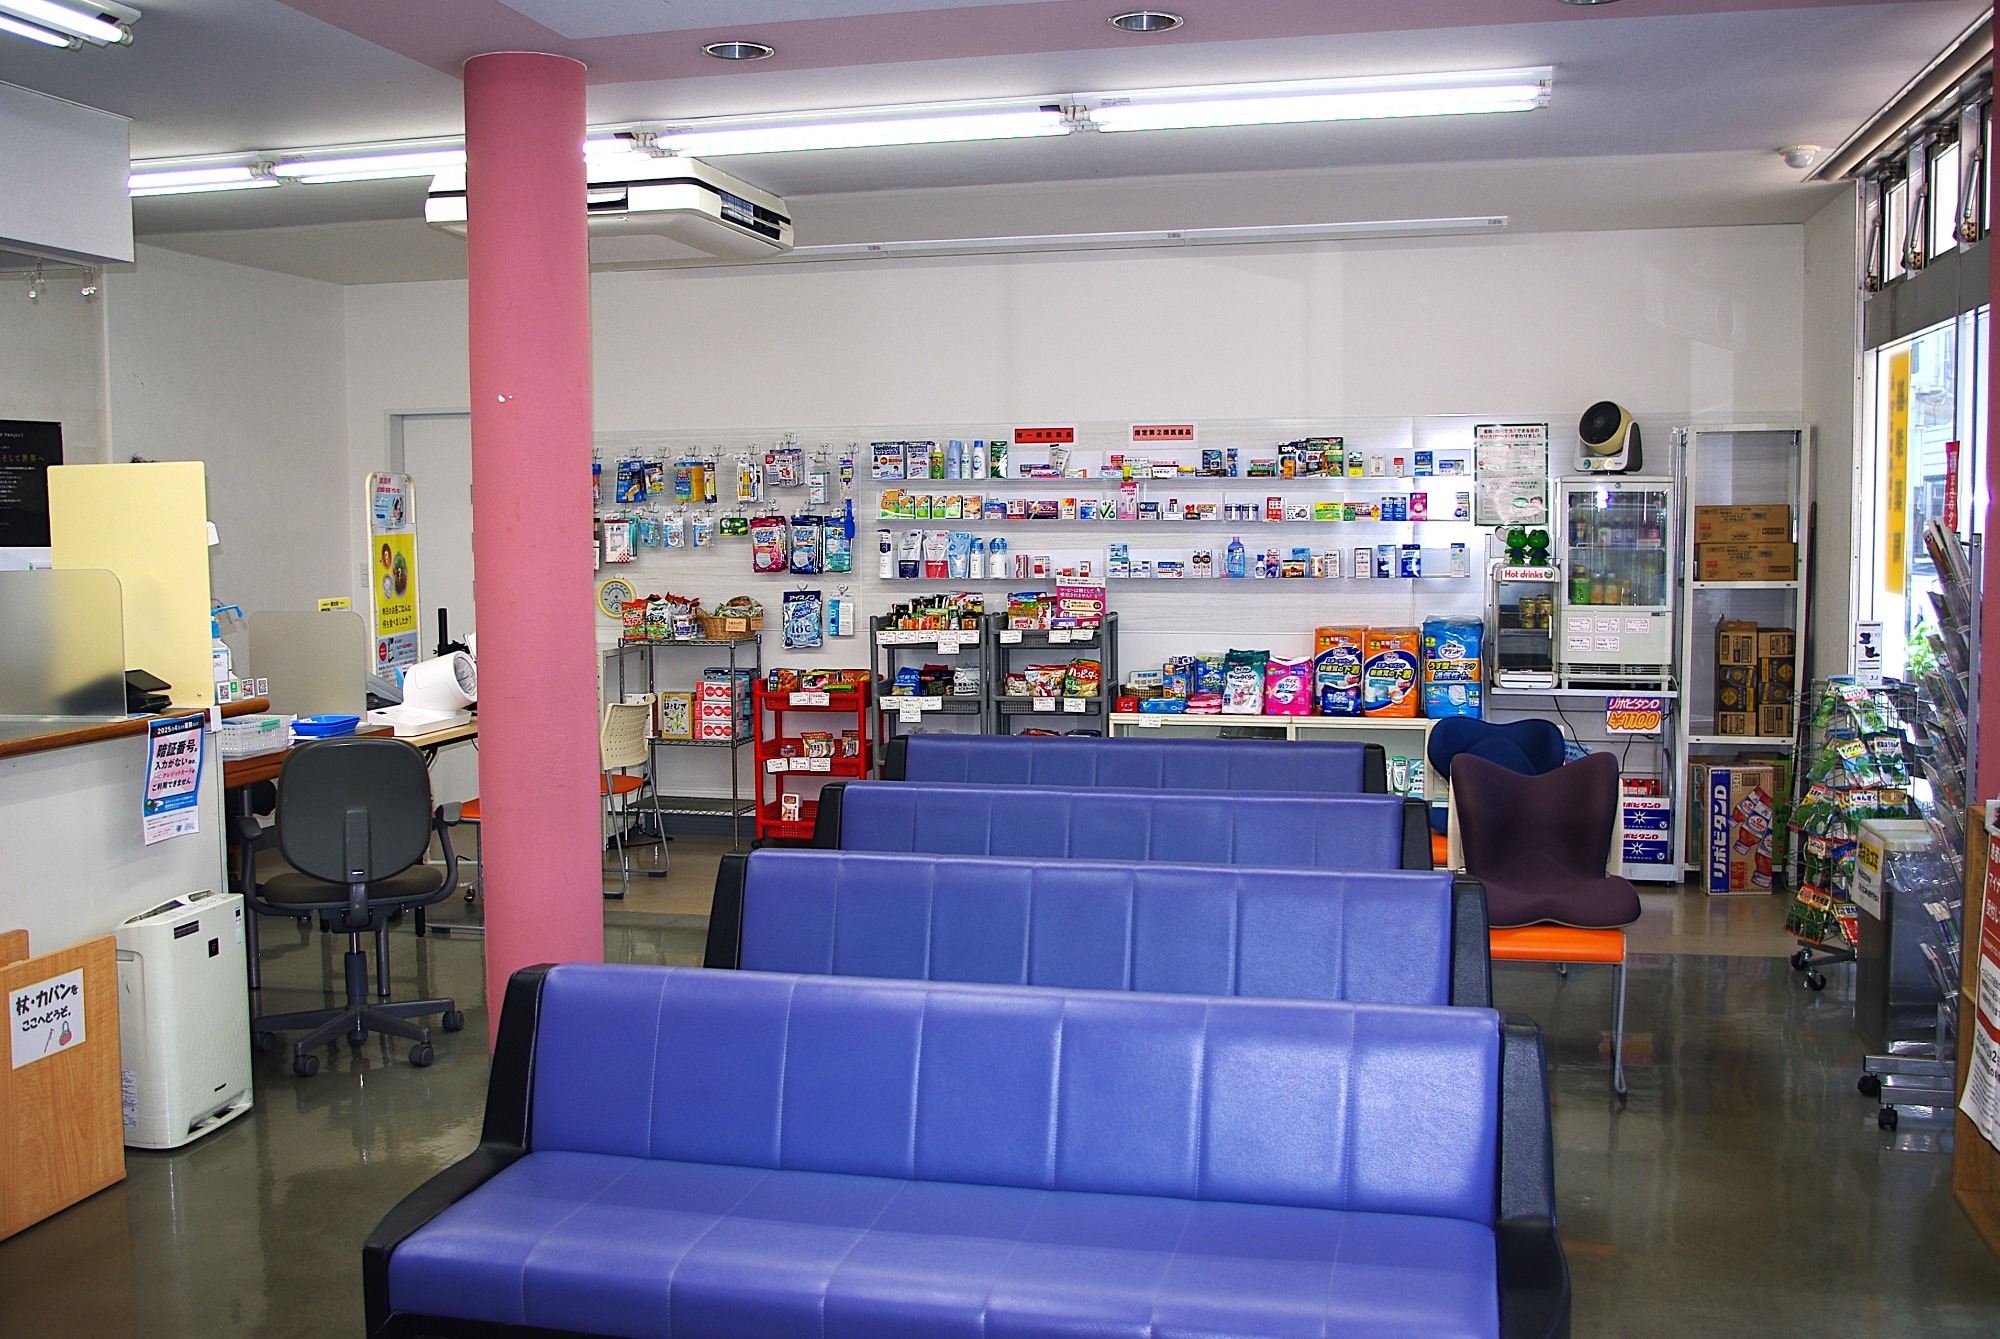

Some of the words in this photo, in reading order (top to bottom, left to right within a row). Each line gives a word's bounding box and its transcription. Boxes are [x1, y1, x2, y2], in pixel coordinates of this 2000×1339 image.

[1134, 428, 1192, 436] 指定第②類医薬品
[1505, 570, 1519, 578] Hot
[1520, 570, 1543, 578] drinks
[664, 699, 687, 710] はとむぎ
[1608, 712, 1660, 730] ¥1100
[1712, 785, 1726, 878] リポビタンD
[16, 984, 78, 1016] 杖・カバンを
